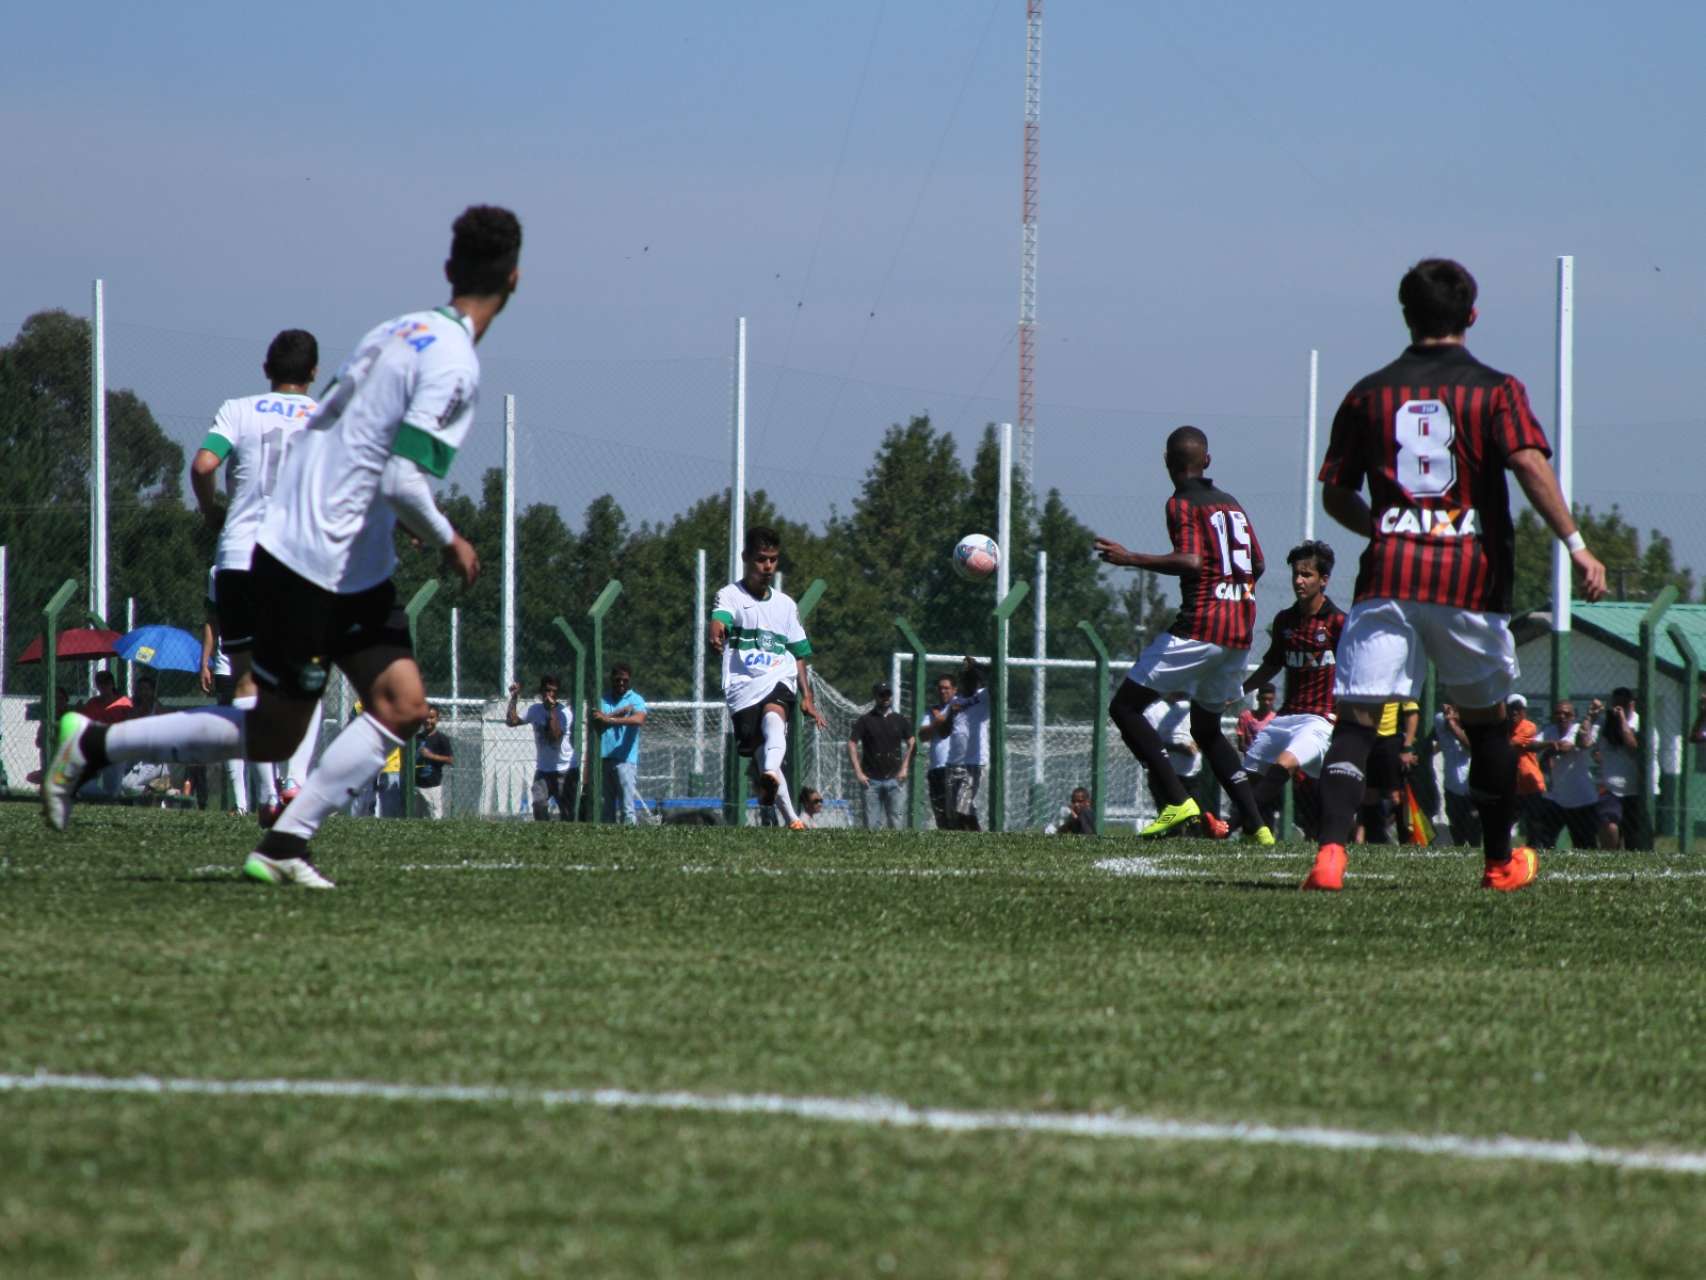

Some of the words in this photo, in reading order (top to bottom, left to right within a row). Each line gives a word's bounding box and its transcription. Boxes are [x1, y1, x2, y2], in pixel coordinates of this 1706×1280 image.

[255, 399, 318, 418] CAIX
[1396, 400, 1457, 497] 8
[1380, 507, 1482, 537] CAIXA
[1210, 510, 1253, 576] 15
[1215, 582, 1256, 601] CAIX
